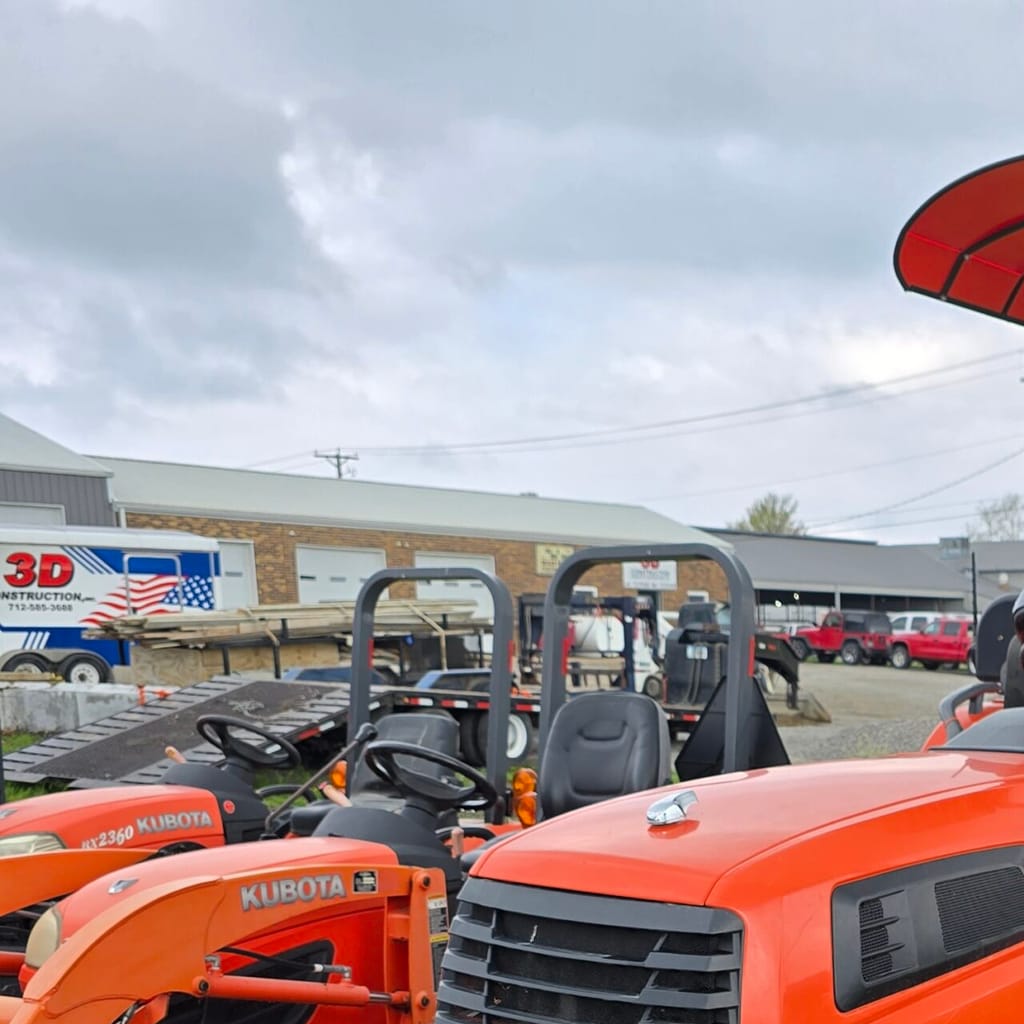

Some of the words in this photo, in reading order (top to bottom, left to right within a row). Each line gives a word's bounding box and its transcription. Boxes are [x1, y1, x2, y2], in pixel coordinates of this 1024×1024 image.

[3, 552, 75, 588] 3D
[136, 811, 212, 834] KUBOTA
[240, 874, 346, 912] KUBOTA
